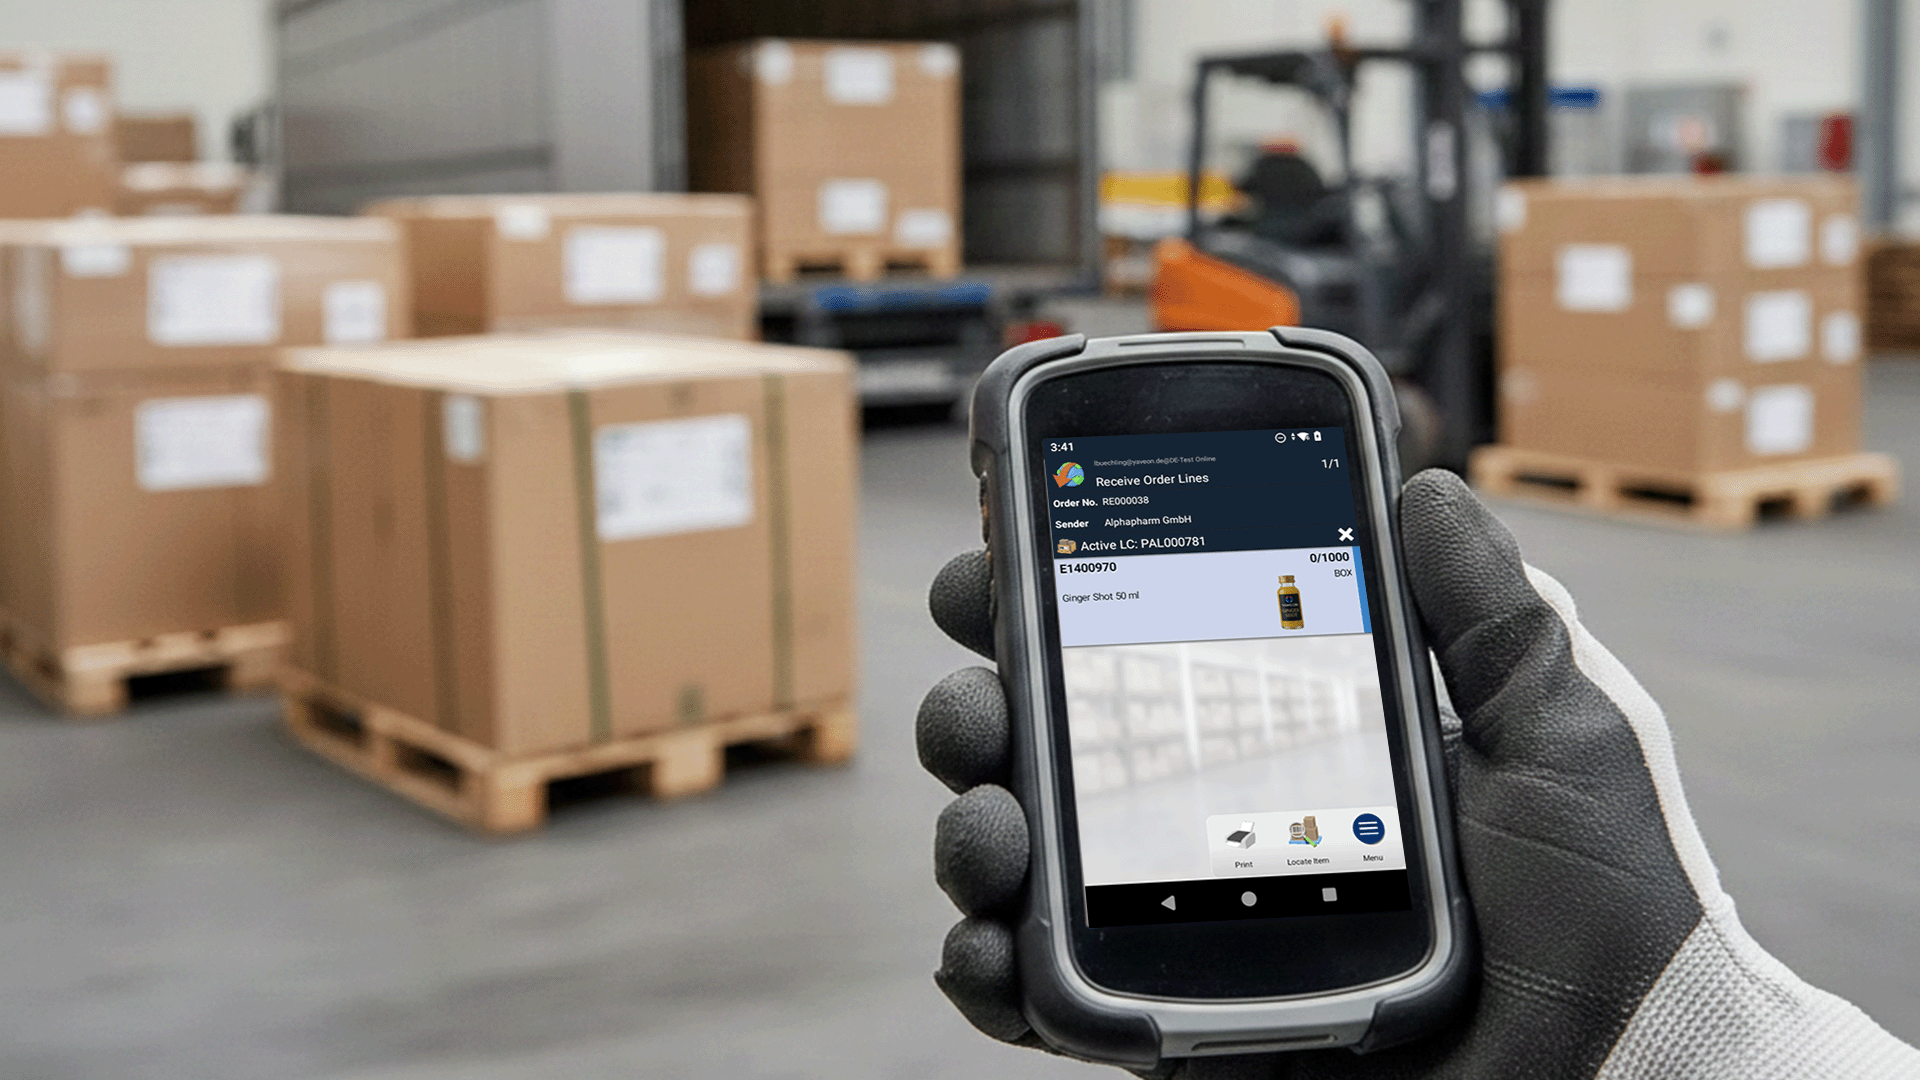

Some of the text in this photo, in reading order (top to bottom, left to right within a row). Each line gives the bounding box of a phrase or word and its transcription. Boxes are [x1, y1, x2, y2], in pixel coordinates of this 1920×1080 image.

[1050, 442, 1074, 453] 3:41
[1194, 455, 1217, 463] Online
[1321, 458, 1340, 469] 1/1
[1095, 473, 1210, 487] Receive Order Lines
[1052, 495, 1150, 508] Order No. RE000038
[1055, 514, 1192, 529] Sender Alphapharm GmbH
[1080, 536, 1205, 552] Active LC: PAL000781
[1309, 551, 1350, 564] 0/1000
[1059, 561, 1117, 574] E1400970
[1333, 568, 1353, 578] BOX
[1061, 590, 1140, 605] Ginger Shot 50 ml
[1286, 857, 1330, 867] Locate Item
[1362, 854, 1384, 862] Menu
[1234, 861, 1254, 869] Print
